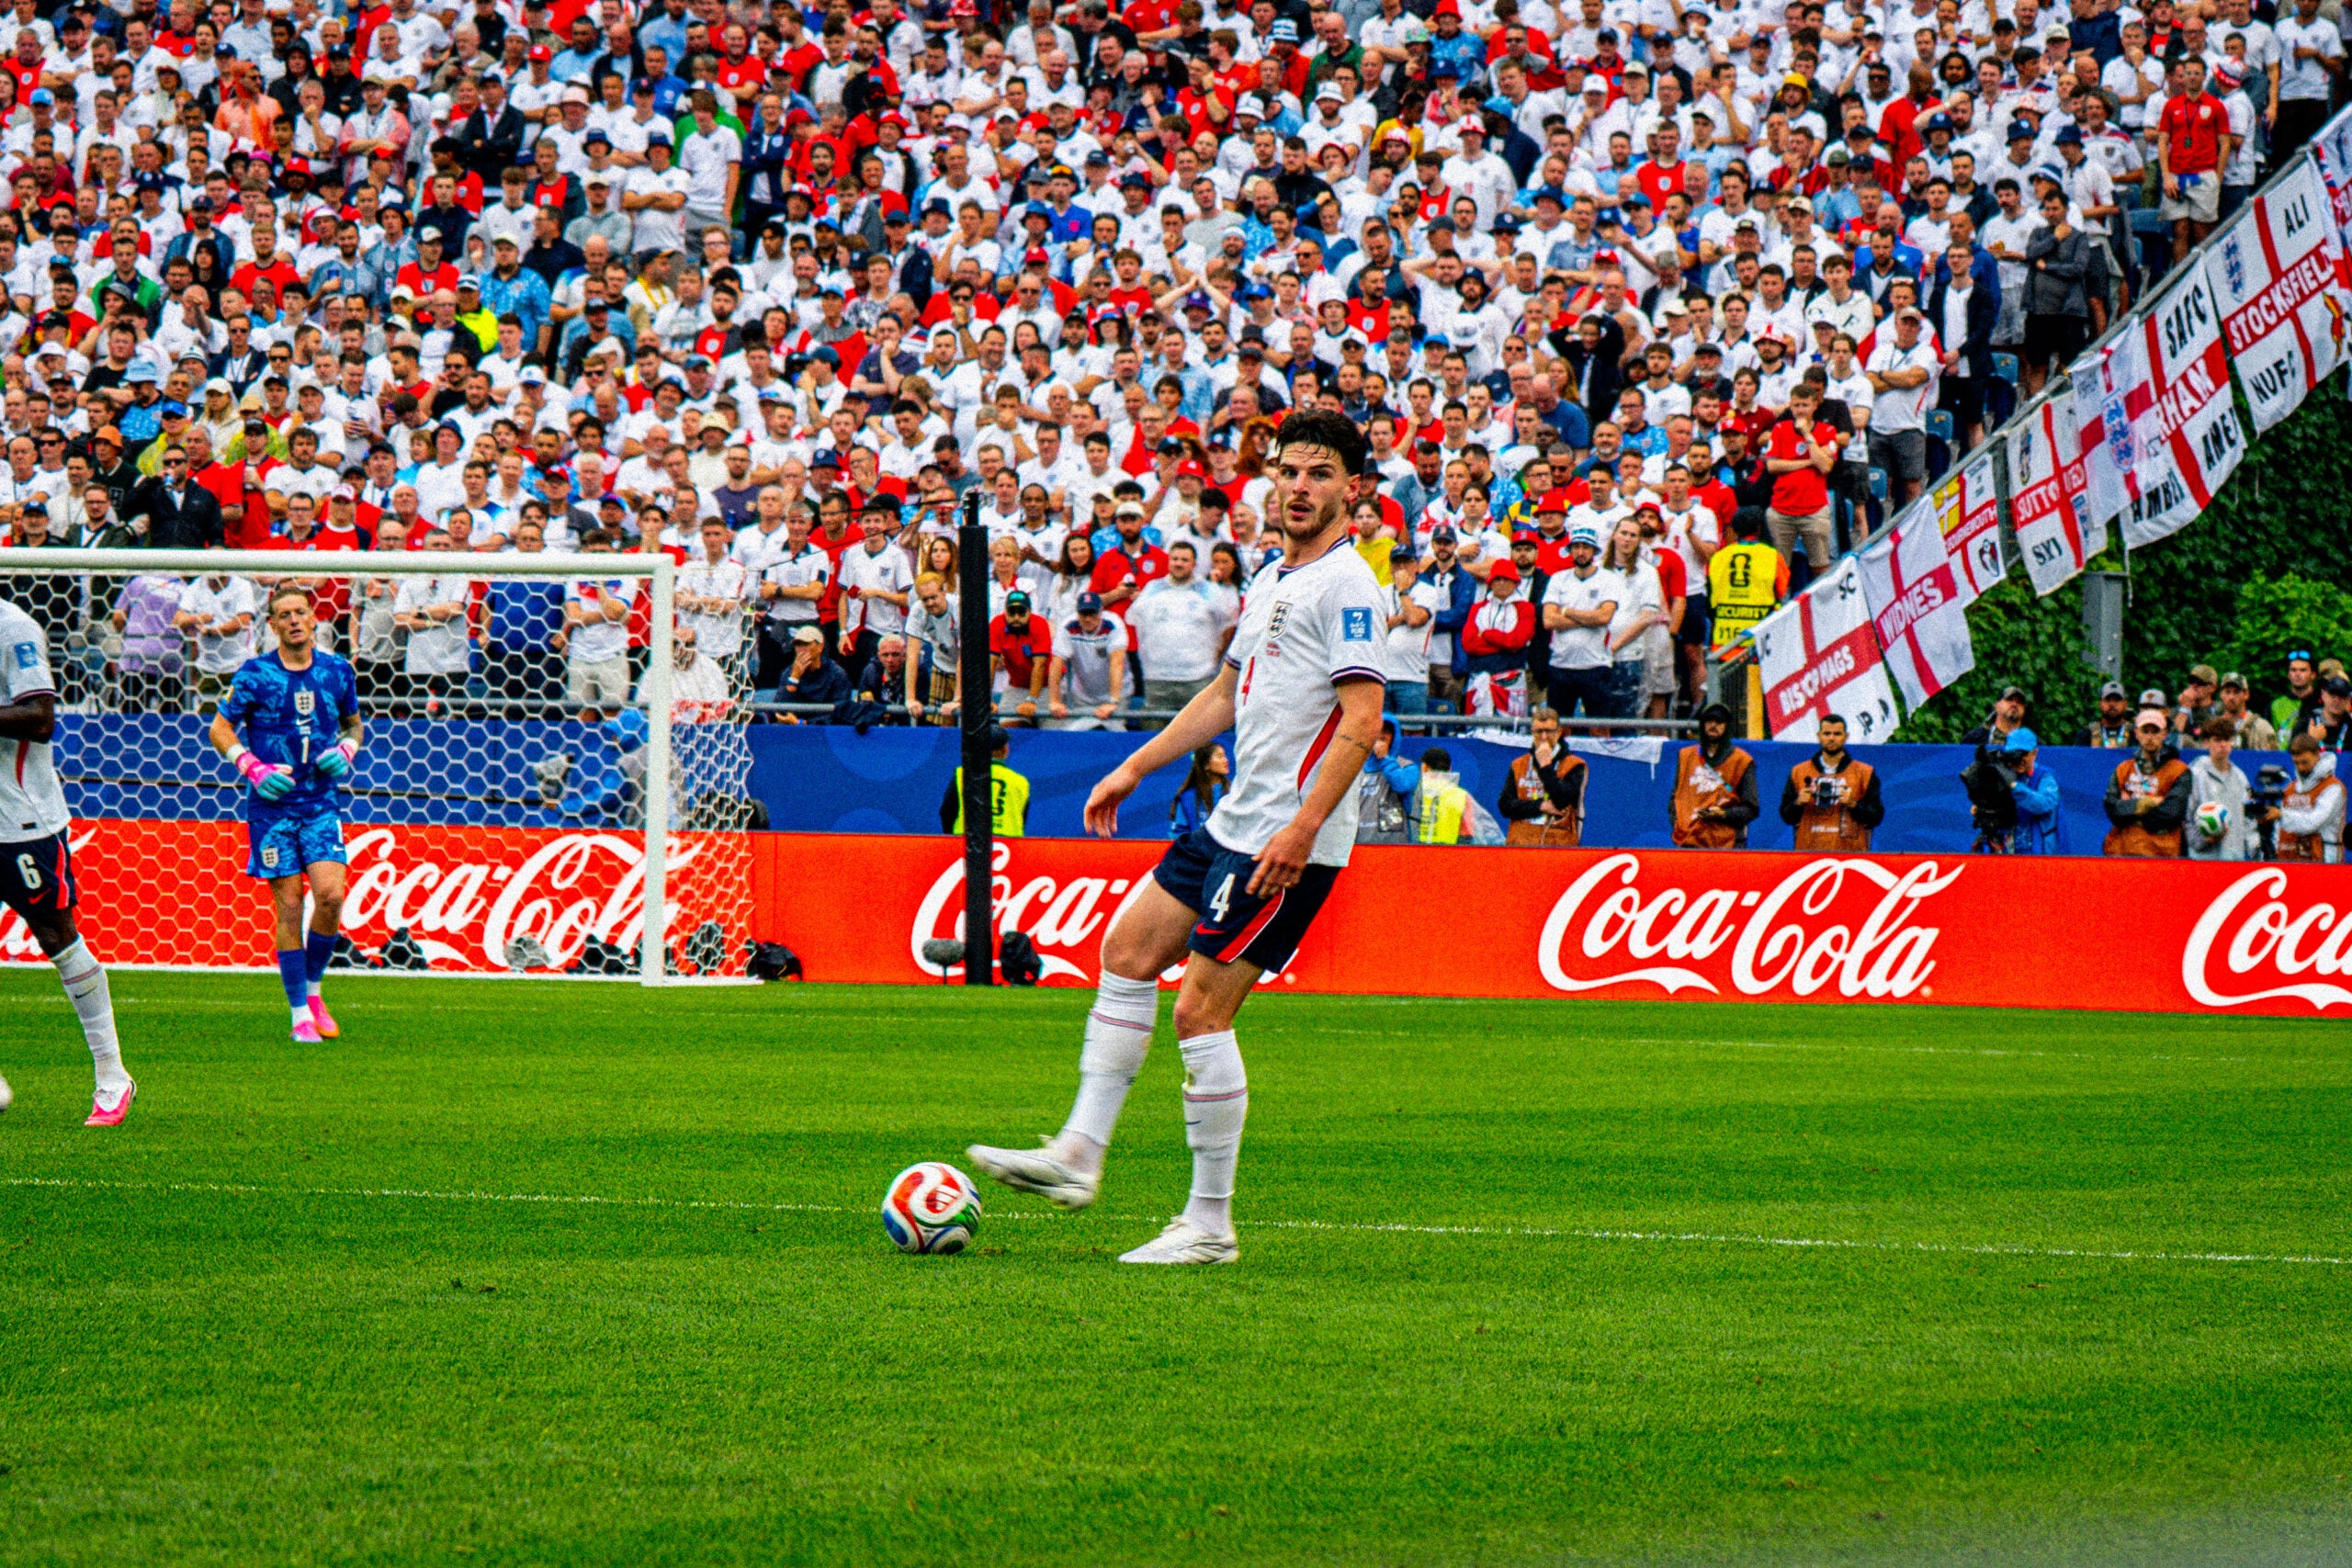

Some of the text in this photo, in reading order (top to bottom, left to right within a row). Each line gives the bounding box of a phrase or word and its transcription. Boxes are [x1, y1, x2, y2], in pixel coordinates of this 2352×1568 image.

[2284, 194, 2310, 238] ALI
[2165, 284, 2207, 359] SAFC
[1880, 577, 1943, 640] WIDNES
[301, 736, 310, 763] 1
[17, 852, 42, 890] 6
[1209, 873, 1237, 922] 4
[1538, 853, 1966, 998] Coca-Cola
